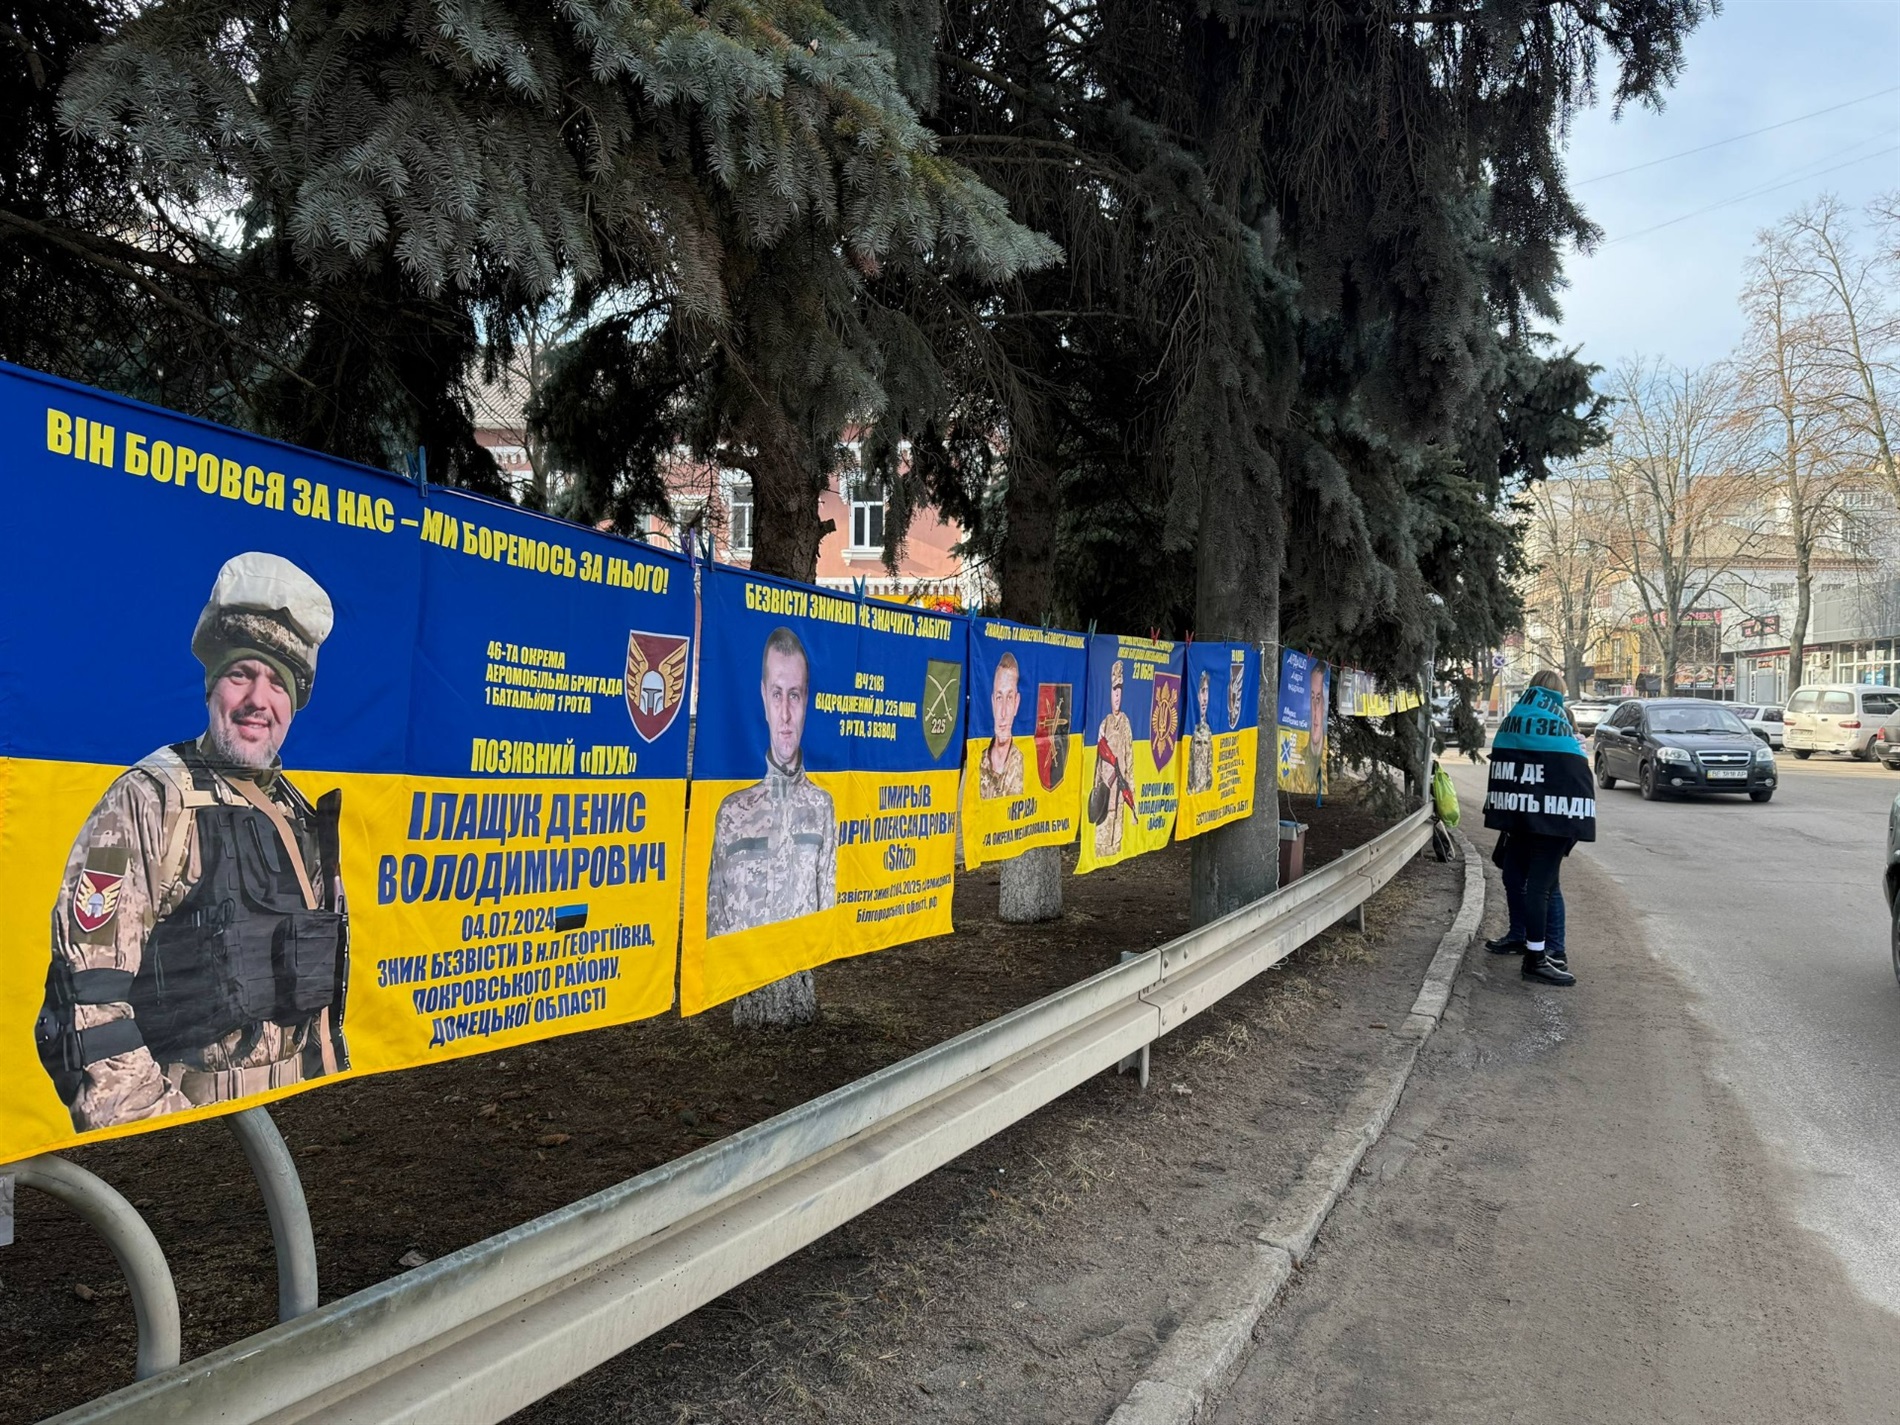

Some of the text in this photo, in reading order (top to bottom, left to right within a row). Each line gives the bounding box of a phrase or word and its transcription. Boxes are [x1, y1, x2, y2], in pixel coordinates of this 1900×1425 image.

[47, 408, 115, 468] ВІН
[125, 432, 285, 511] БОРОВСЯ
[293, 478, 331, 521] ЗА
[337, 488, 394, 533] НАС
[420, 507, 458, 549] МИ
[462, 521, 576, 578] БОРЕМОСЬ
[579, 551, 602, 583] ЗА
[606, 557, 669, 594] НЬОГО!
[745, 582, 808, 617] БЕЗВІСТИ
[858, 604, 870, 628] НЕ
[871, 607, 915, 637] ЗНАЧИТЬ
[487, 640, 565, 669] 46-ТА ОКРЕМА
[485, 663, 622, 696] АЕРОМОБІЛЬНА БРИГАДА
[485, 686, 591, 714] 1 БАТАЛЬЙОН 1 РОТА
[815, 692, 874, 715] ВІДРЯДЖЕНИЙ
[874, 698, 884, 717] ДО
[885, 700, 898, 716] 225
[873, 722, 896, 741] ВЗВОД
[931, 718, 946, 734] 225
[471, 738, 637, 775] ПОЗИВНИЙ «ПУХ»
[1520, 763, 1545, 785] ДЕ
[407, 790, 646, 846] ІЛАЩУК ДЕНИС
[377, 842, 666, 906] ВОЛОДИМИРОВИЧ
[837, 888, 873, 904] езвісти
[462, 906, 555, 942] 04.07.2024
[377, 953, 427, 988] ЗНИК
[431, 941, 518, 976] БЕЗВІСТИ
[522, 940, 533, 963] В
[562, 923, 655, 957] ГЕОРГІЇВКА,
[412, 955, 621, 1015] ПОКРОВСЬКОГО РАЙОНУ,
[428, 987, 606, 1049] ДОНЕЦЬКОЇ ОБЛАСТІ
